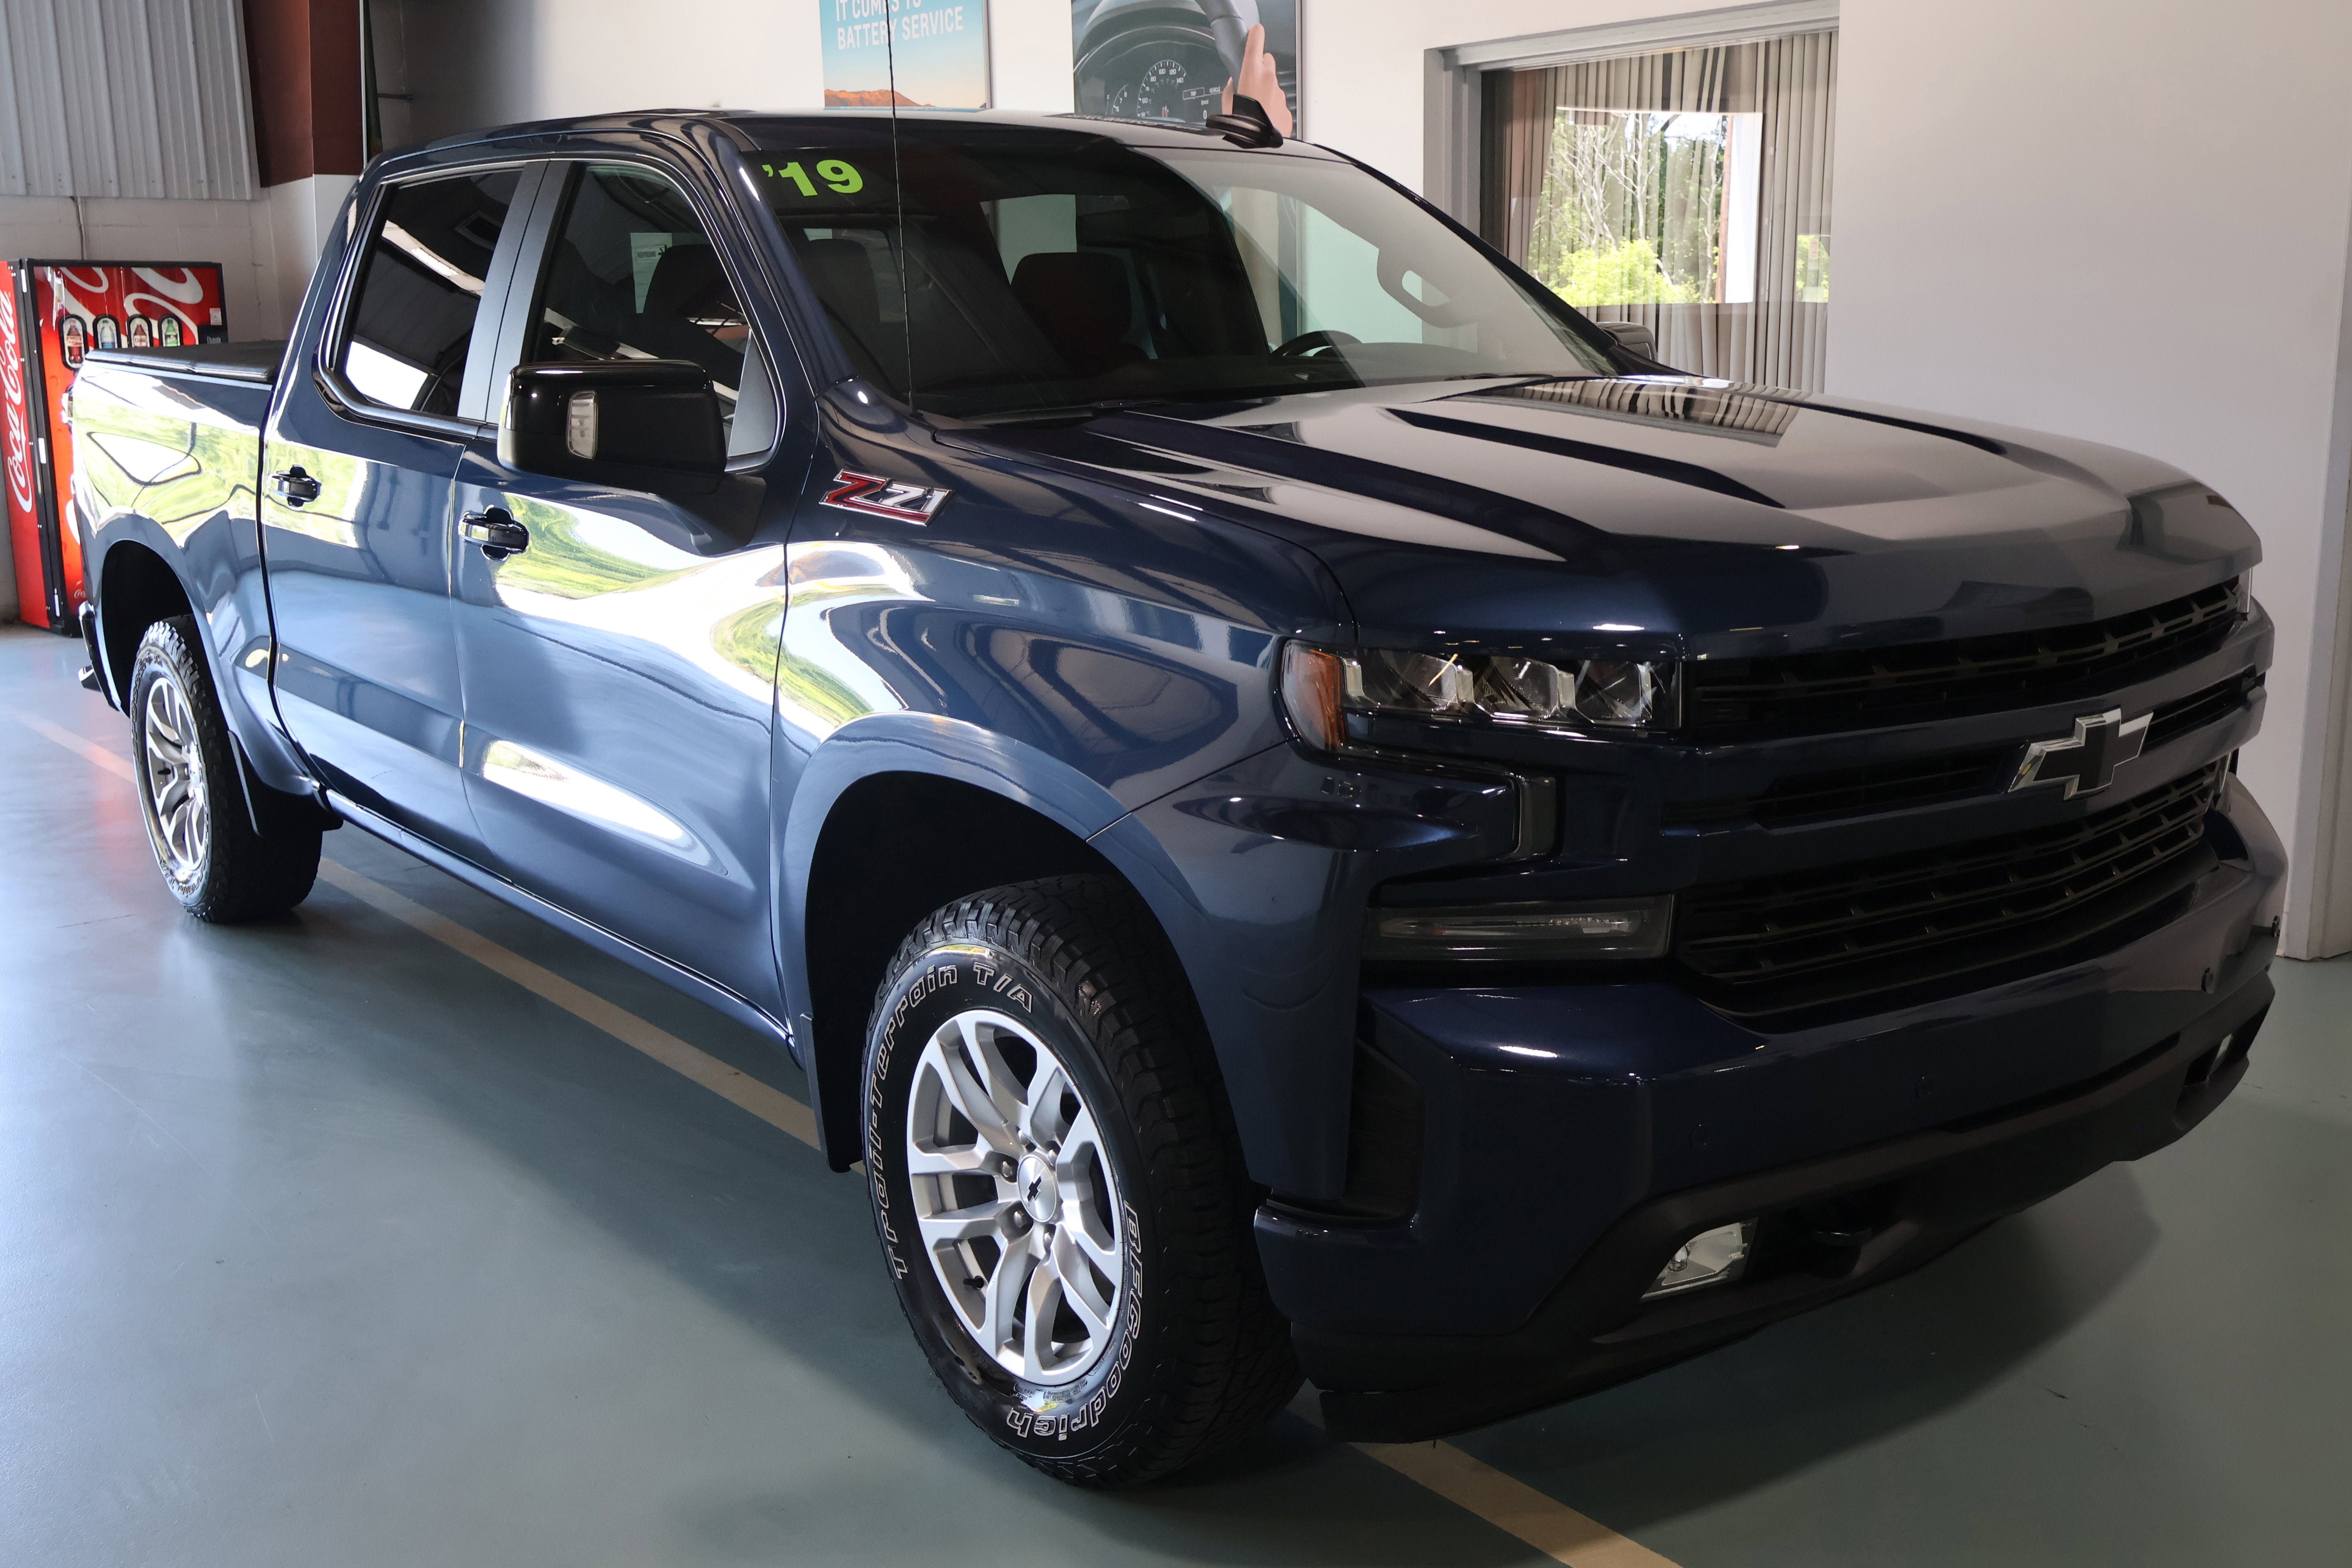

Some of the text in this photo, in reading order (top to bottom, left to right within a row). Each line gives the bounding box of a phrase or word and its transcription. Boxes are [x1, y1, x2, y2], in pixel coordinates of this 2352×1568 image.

[835, 0, 847, 21] IT
[837, 6, 964, 50] BATTERY SERVICE
[762, 159, 863, 196] '19
[0, 290, 33, 513] Coca-Cola
[818, 468, 956, 526] Z71
[973, 962, 1033, 1013] T/A
[1006, 1200, 1143, 1441] BFGoodrich
